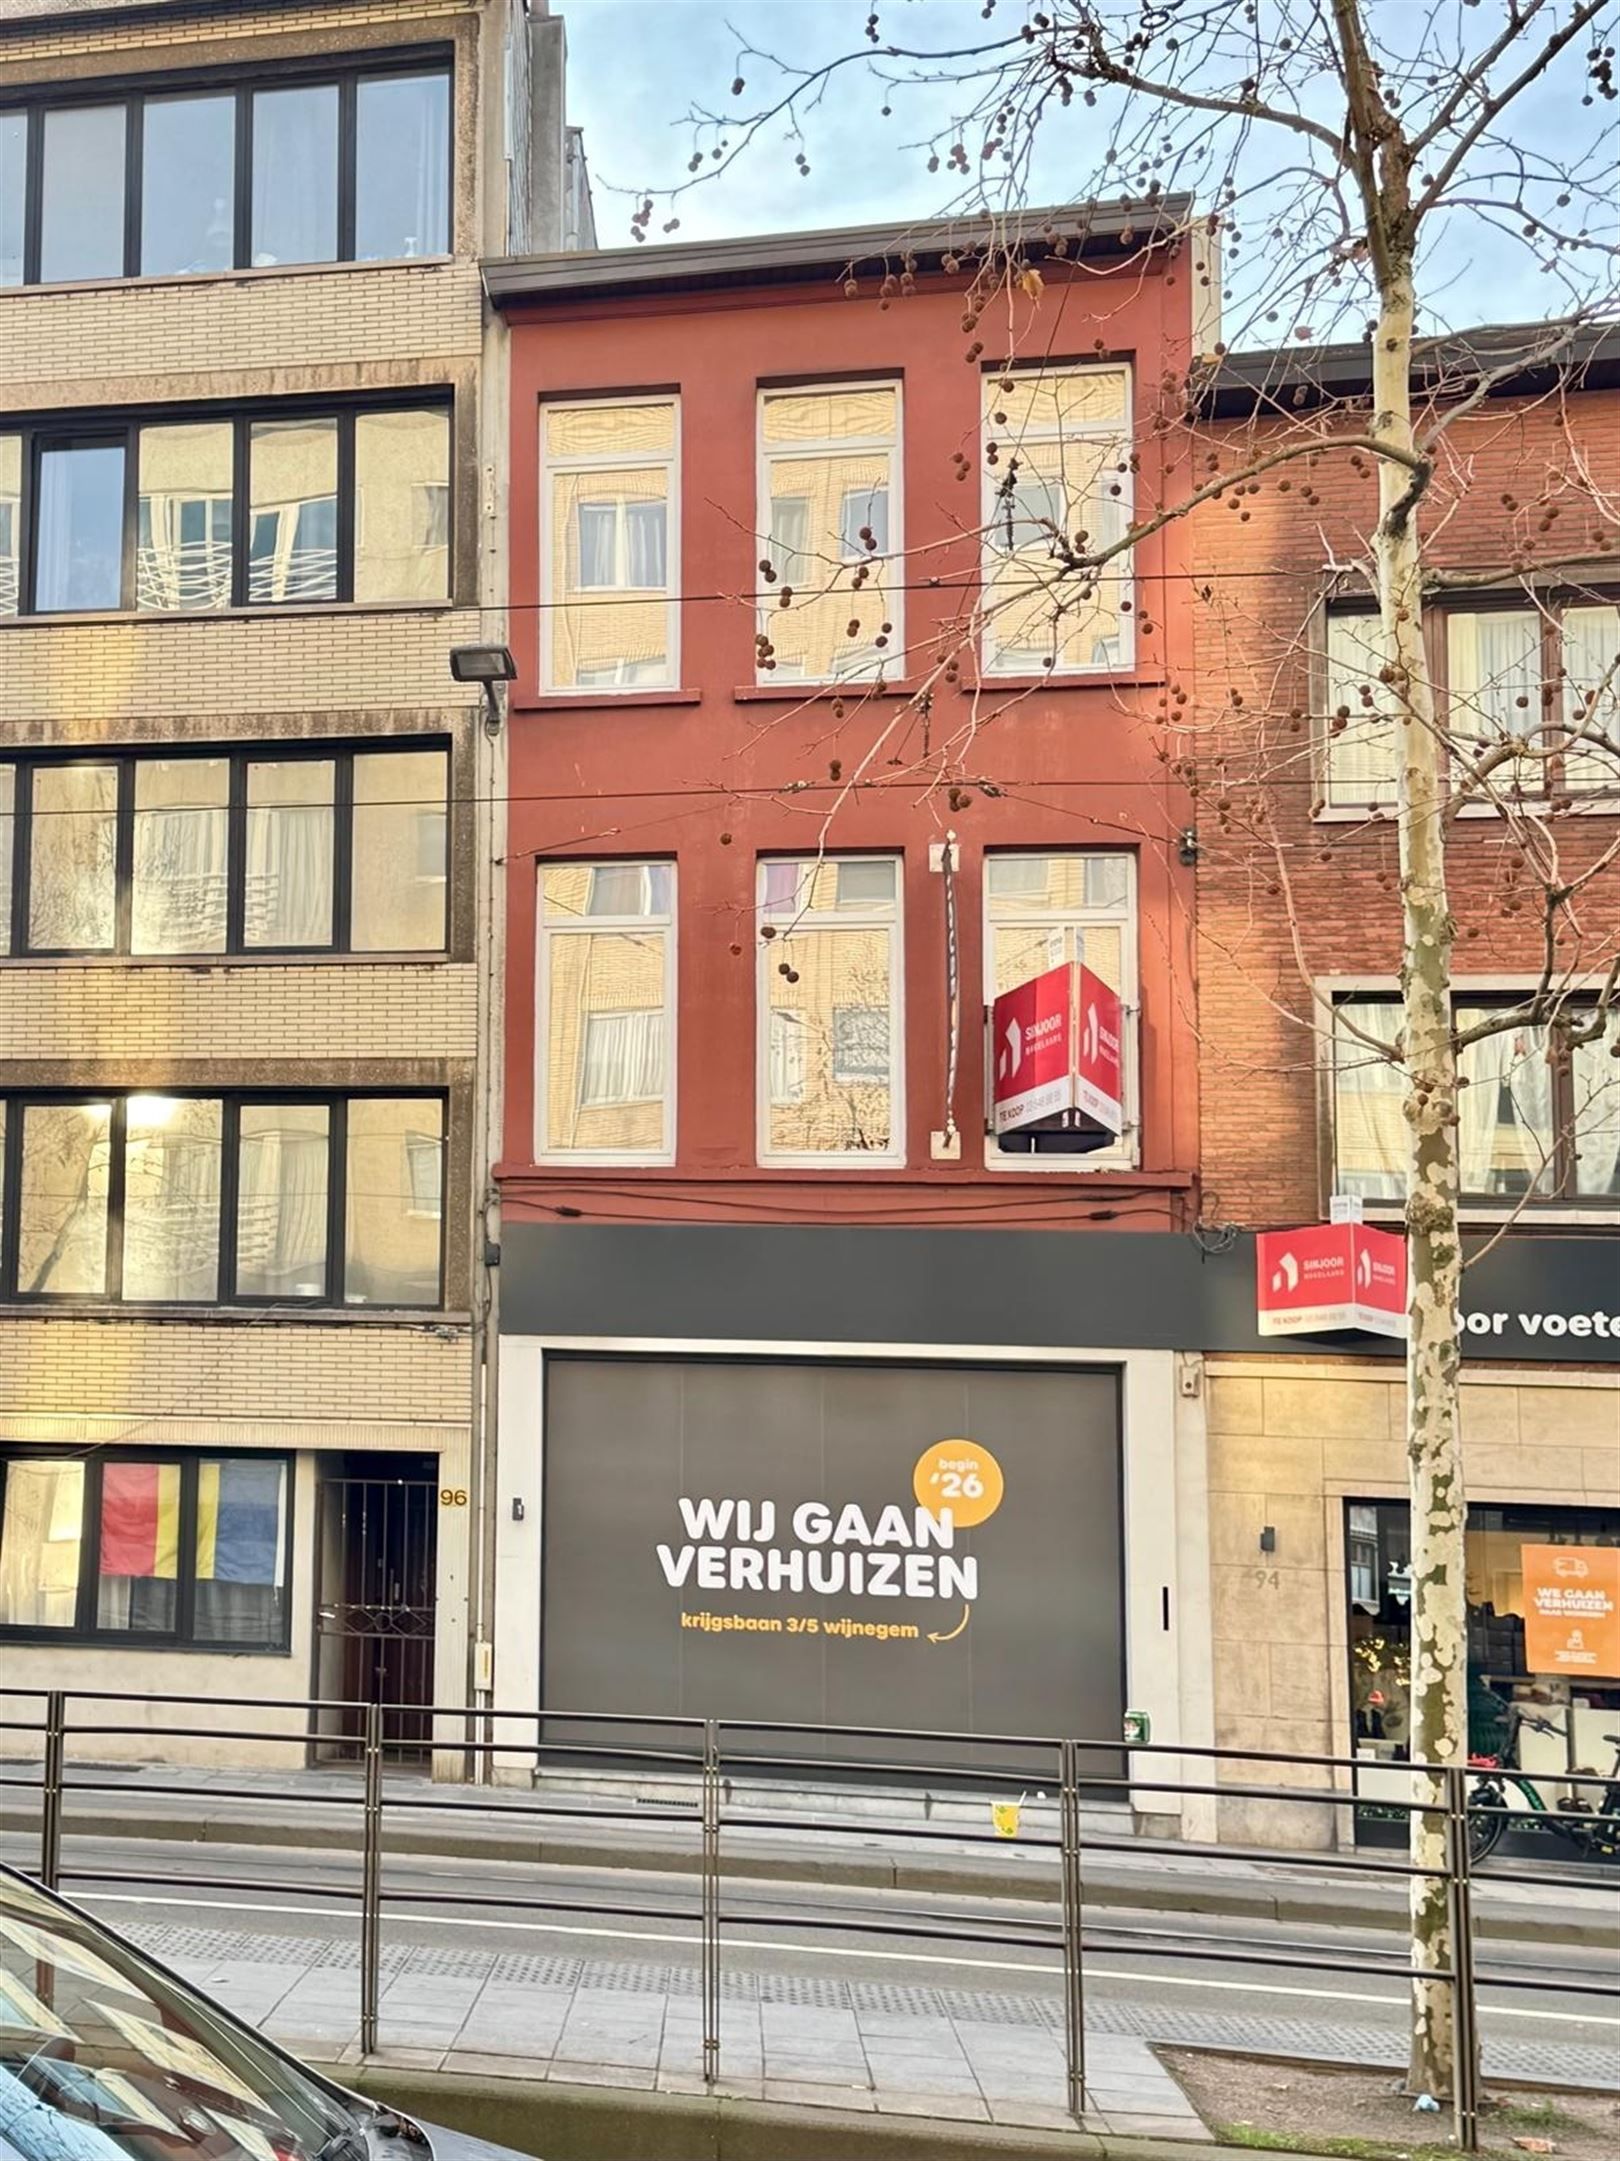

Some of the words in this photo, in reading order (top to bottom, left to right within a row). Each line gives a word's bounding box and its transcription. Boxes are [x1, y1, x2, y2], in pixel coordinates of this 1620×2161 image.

[1303, 1255, 1345, 1271] SINJOOR
[938, 1458, 979, 1473] begin
[440, 1489, 468, 1506] 96
[678, 1497, 776, 1543] WIJ
[792, 1502, 954, 1549] GAAN
[656, 1543, 978, 1600] VERHUIZEN
[1255, 1569, 1280, 1590] 94
[1537, 1587, 1561, 1598] WE
[1563, 1588, 1606, 1600] GAAN
[1533, 1597, 1614, 1612] VERHUIZEN
[681, 1612, 782, 1634] krijgsbaan
[787, 1617, 819, 1634] 3/5
[824, 1619, 919, 1640] wijnegem
